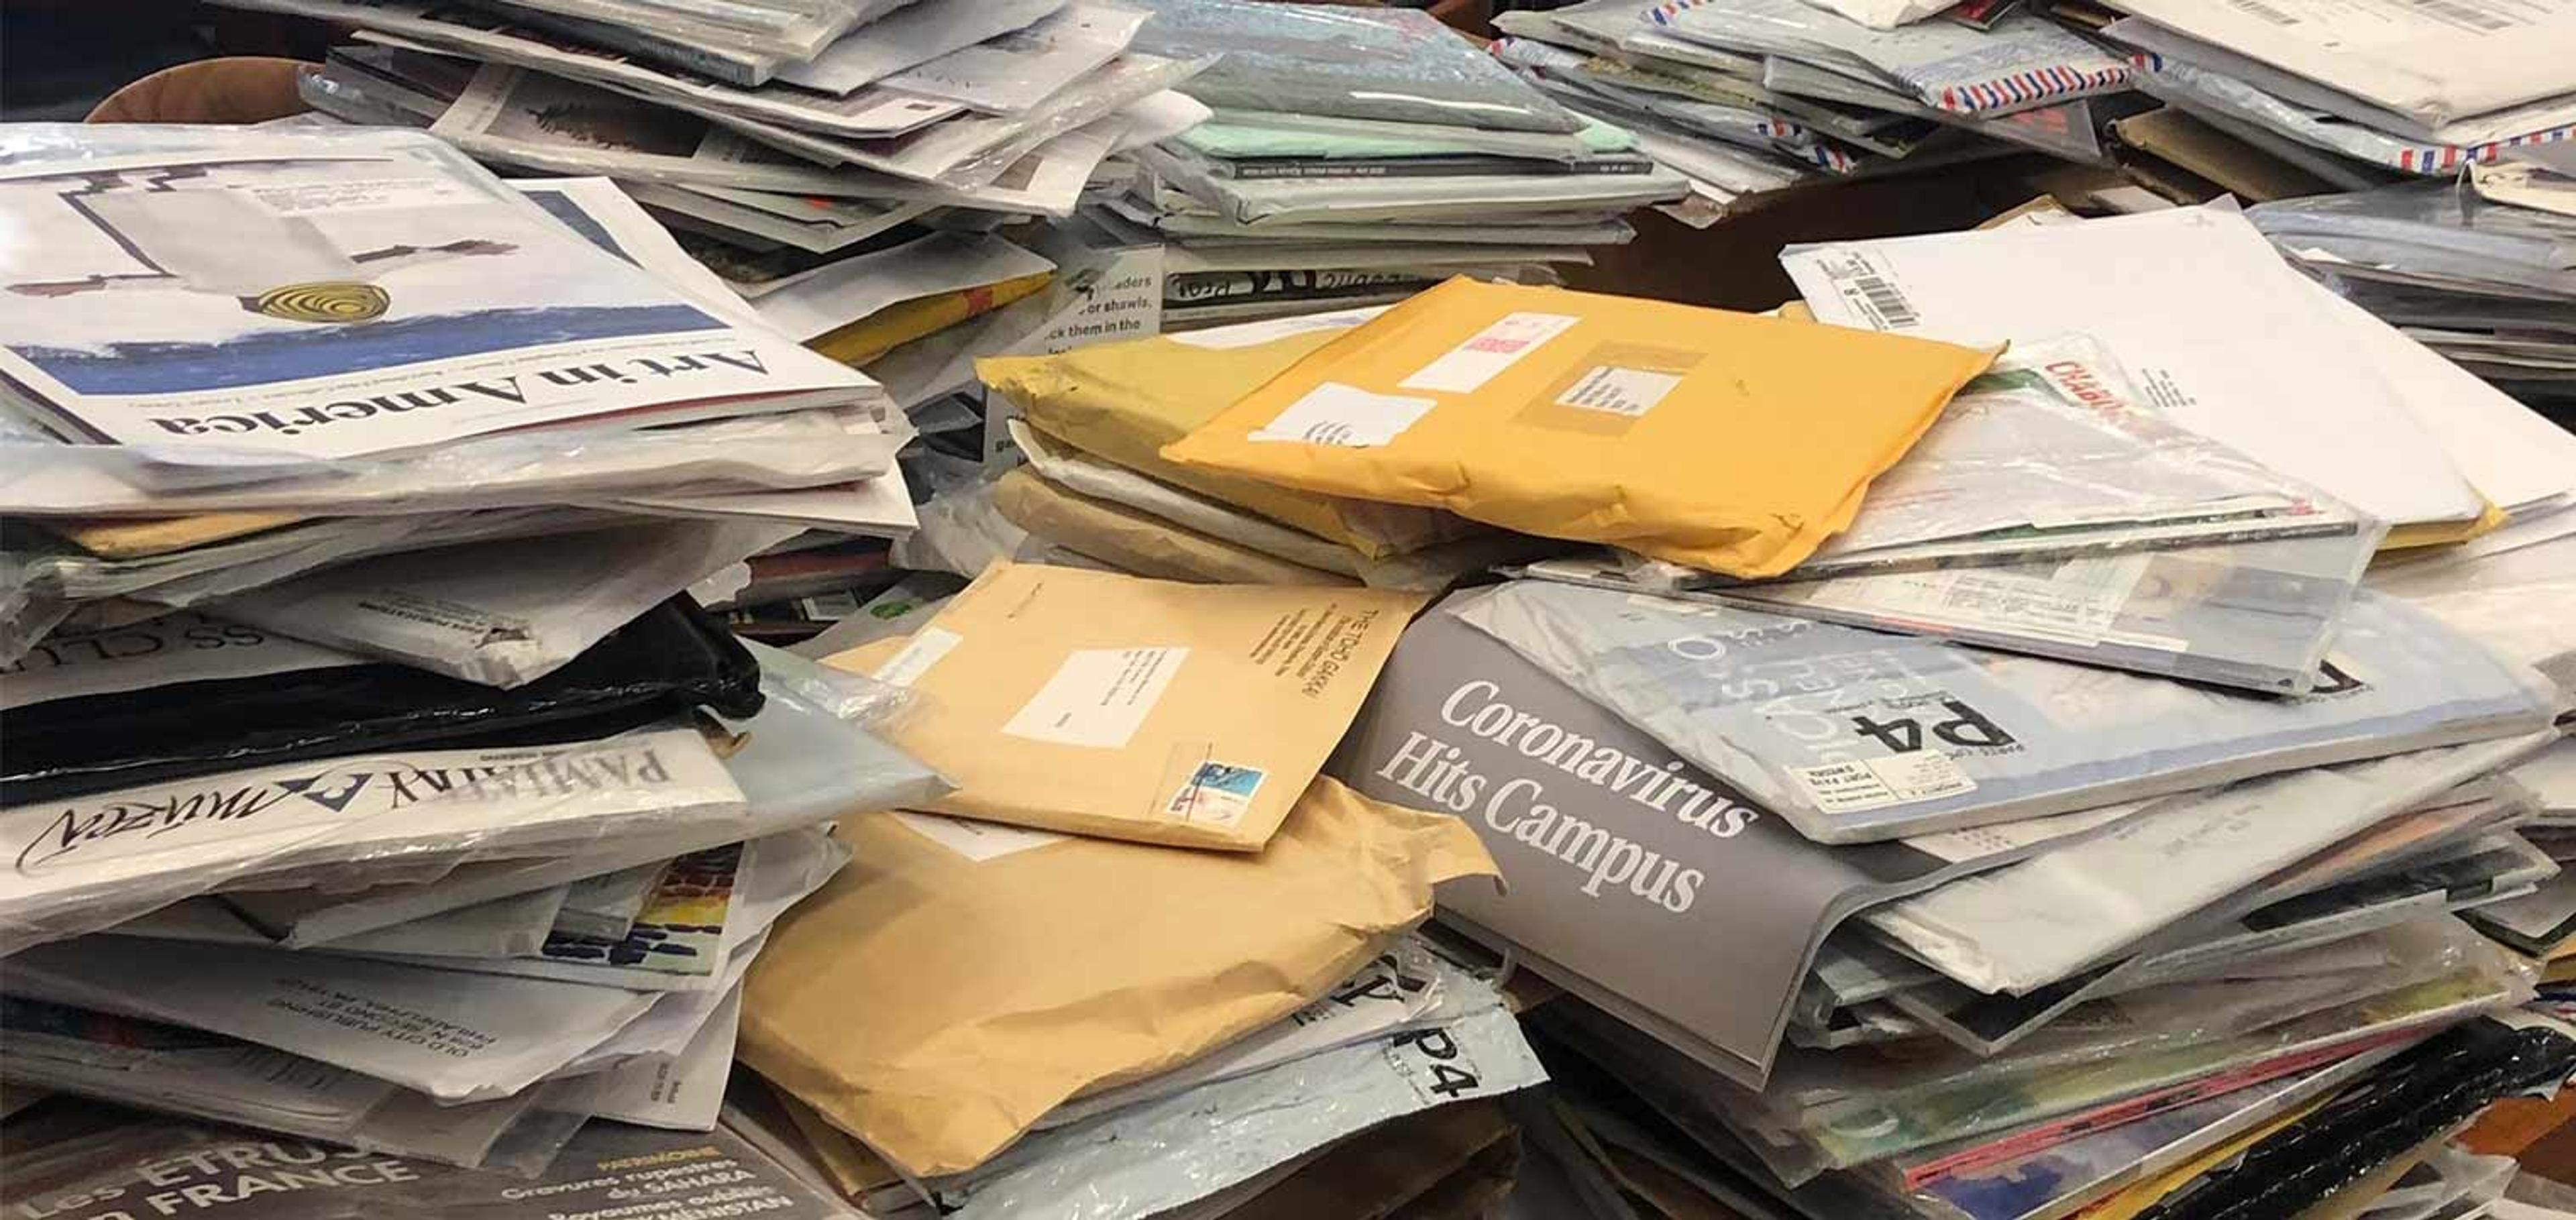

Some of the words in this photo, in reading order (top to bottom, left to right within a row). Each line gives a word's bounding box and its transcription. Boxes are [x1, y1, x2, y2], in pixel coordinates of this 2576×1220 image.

[1068, 322, 1102, 336] them
[1106, 319, 1118, 331] in
[1119, 319, 1141, 331] the
[537, 364, 638, 384] in
[627, 350, 768, 376] Art
[148, 376, 526, 435] America
[1350, 610, 1379, 630] THE
[1330, 632, 1363, 662] TOHO
[1850, 700, 2018, 755] P4
[1441, 680, 1758, 838] Coronavirus
[1375, 730, 1487, 812] Hits
[1485, 778, 1705, 913] Campus
[1391, 1027, 1481, 1099] P4
[146, 1159, 421, 1215] FRANCE
[501, 1176, 621, 1200] Gravures
[625, 1158, 738, 1183] rupestres
[606, 1186, 641, 1200] du
[643, 1169, 757, 1194] SAHARA
